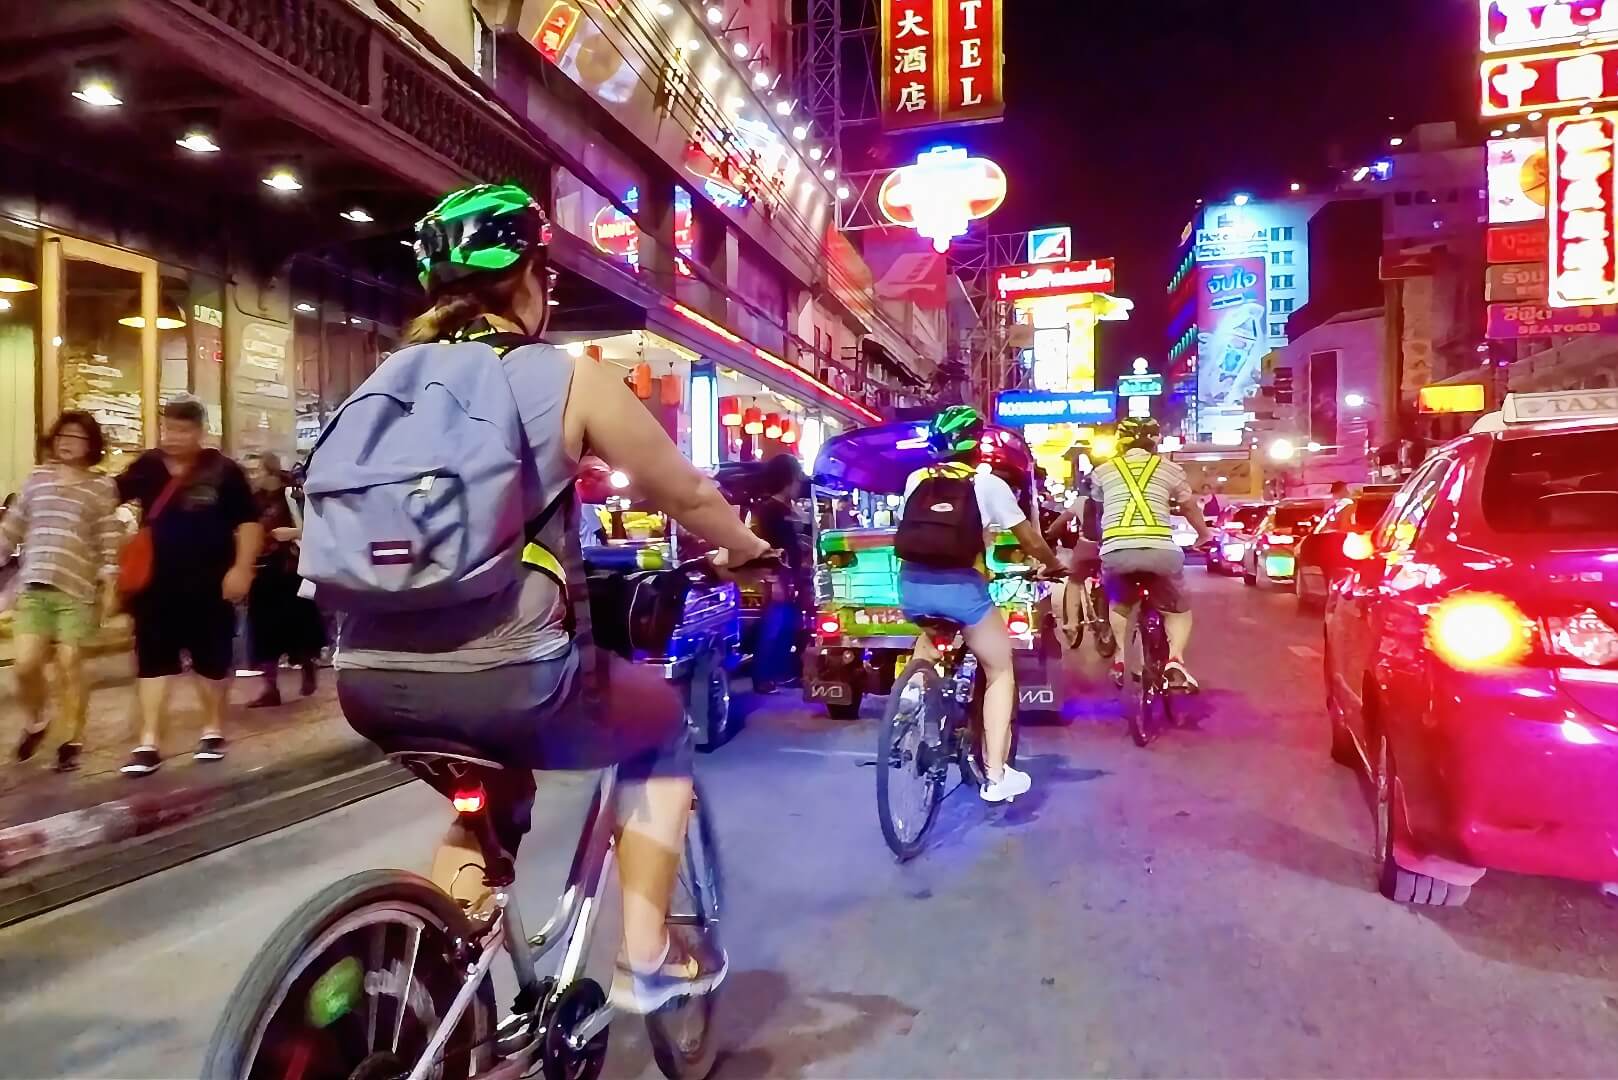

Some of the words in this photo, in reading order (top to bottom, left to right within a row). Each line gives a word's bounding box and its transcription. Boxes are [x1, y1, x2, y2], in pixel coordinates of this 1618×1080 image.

[894, 9, 930, 113] 大酒店
[959, 1, 983, 106] TEL
[1518, 322, 1600, 335] SEAFOOD
